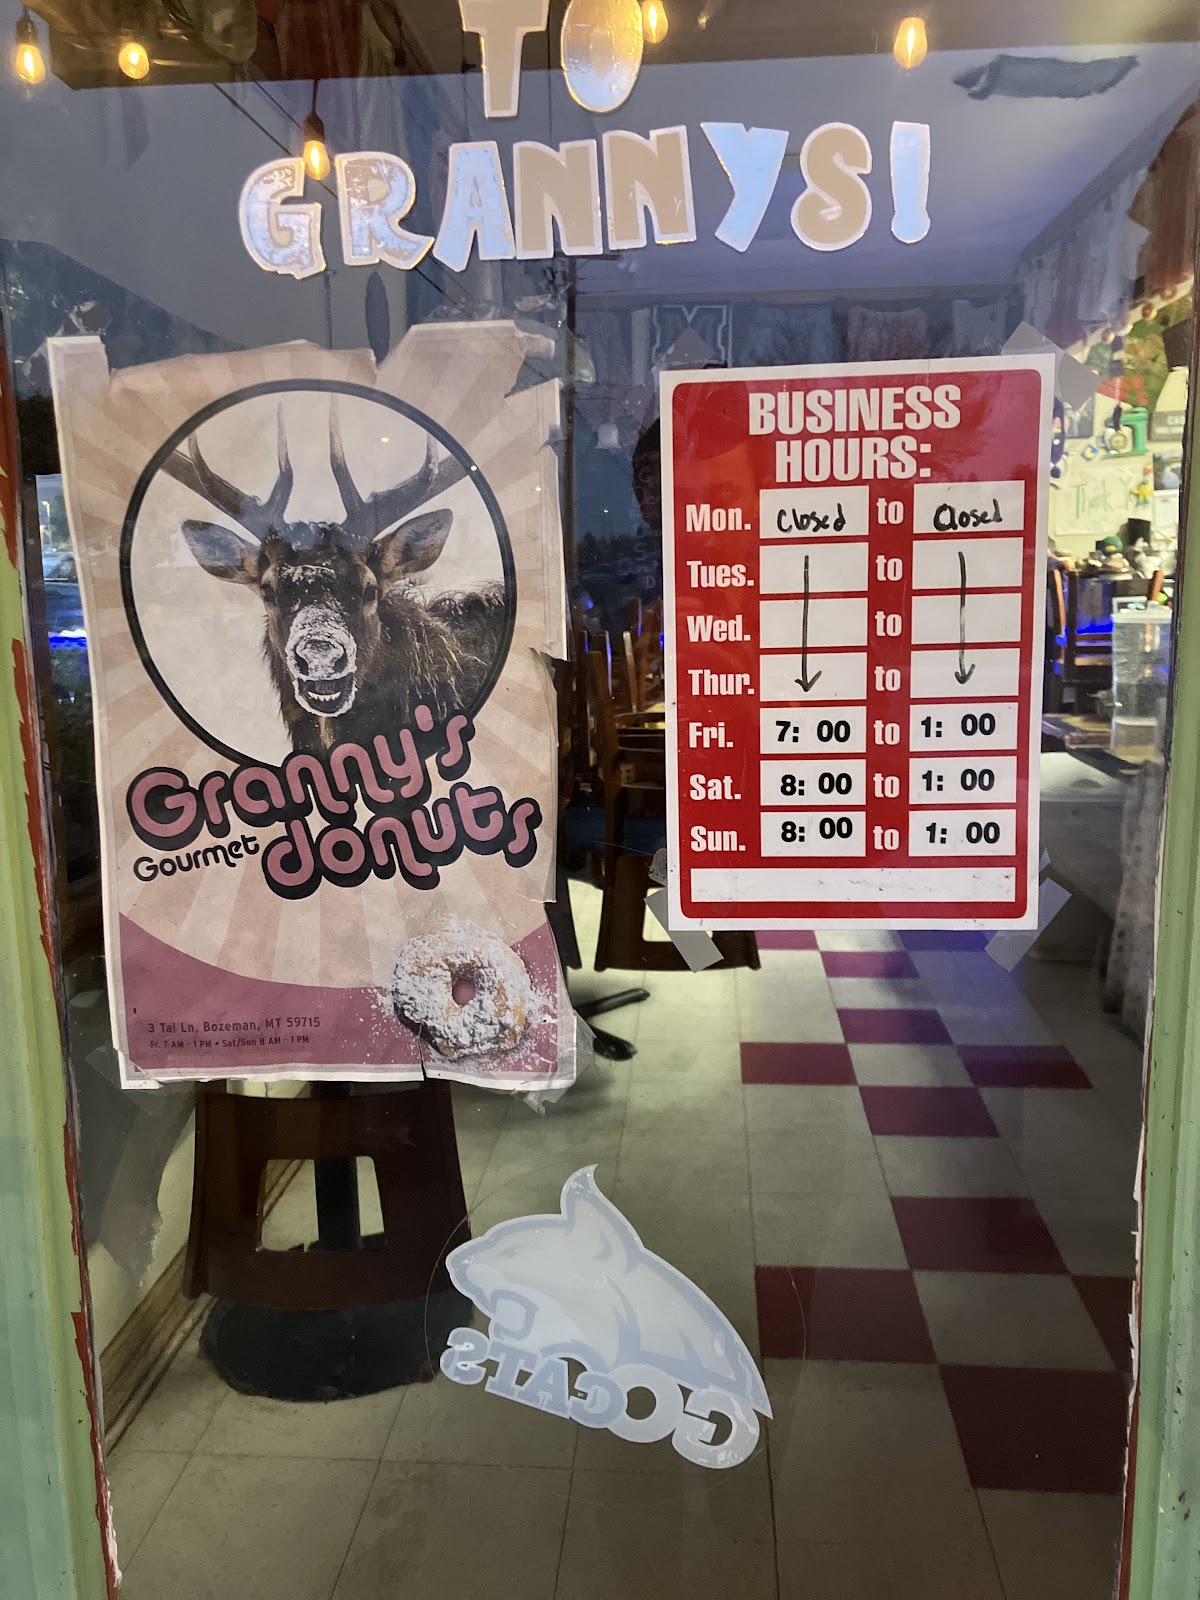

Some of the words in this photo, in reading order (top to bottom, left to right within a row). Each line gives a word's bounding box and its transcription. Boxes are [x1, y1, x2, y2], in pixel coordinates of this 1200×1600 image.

[458, 0, 645, 119] TO
[239, 120, 932, 279] GRANNYS!
[748, 384, 962, 436] BUSINESS
[774, 435, 932, 483] HOURS:
[686, 504, 752, 532] Mon.
[776, 502, 847, 533] Closed
[876, 497, 904, 525] to
[686, 560, 755, 588] Tues.
[875, 555, 903, 581] to
[686, 614, 752, 642] Wed.
[874, 611, 903, 637] to
[688, 669, 755, 696] Thur.
[873, 666, 902, 692] to
[688, 721, 734, 748] Fri.
[873, 719, 901, 746] to
[129, 703, 471, 841] Granny's
[689, 774, 742, 800] Sat.
[872, 772, 900, 798] to
[132, 834, 260, 883] Gourmet
[264, 785, 539, 890] donuts
[690, 826, 746, 852] Sun.
[872, 825, 900, 851] to
[148, 1023, 155, 1033] 3
[160, 1022, 176, 1033] Tai
[180, 1022, 199, 1034] Ln,
[203, 1021, 260, 1033] Bozeman,
[265, 1018, 281, 1028] MT
[286, 1016, 320, 1028] 59715
[171, 1040, 184, 1048] AM
[199, 1040, 212, 1048] PM
[268, 1036, 281, 1045] AM
[297, 1035, 309, 1043] PM
